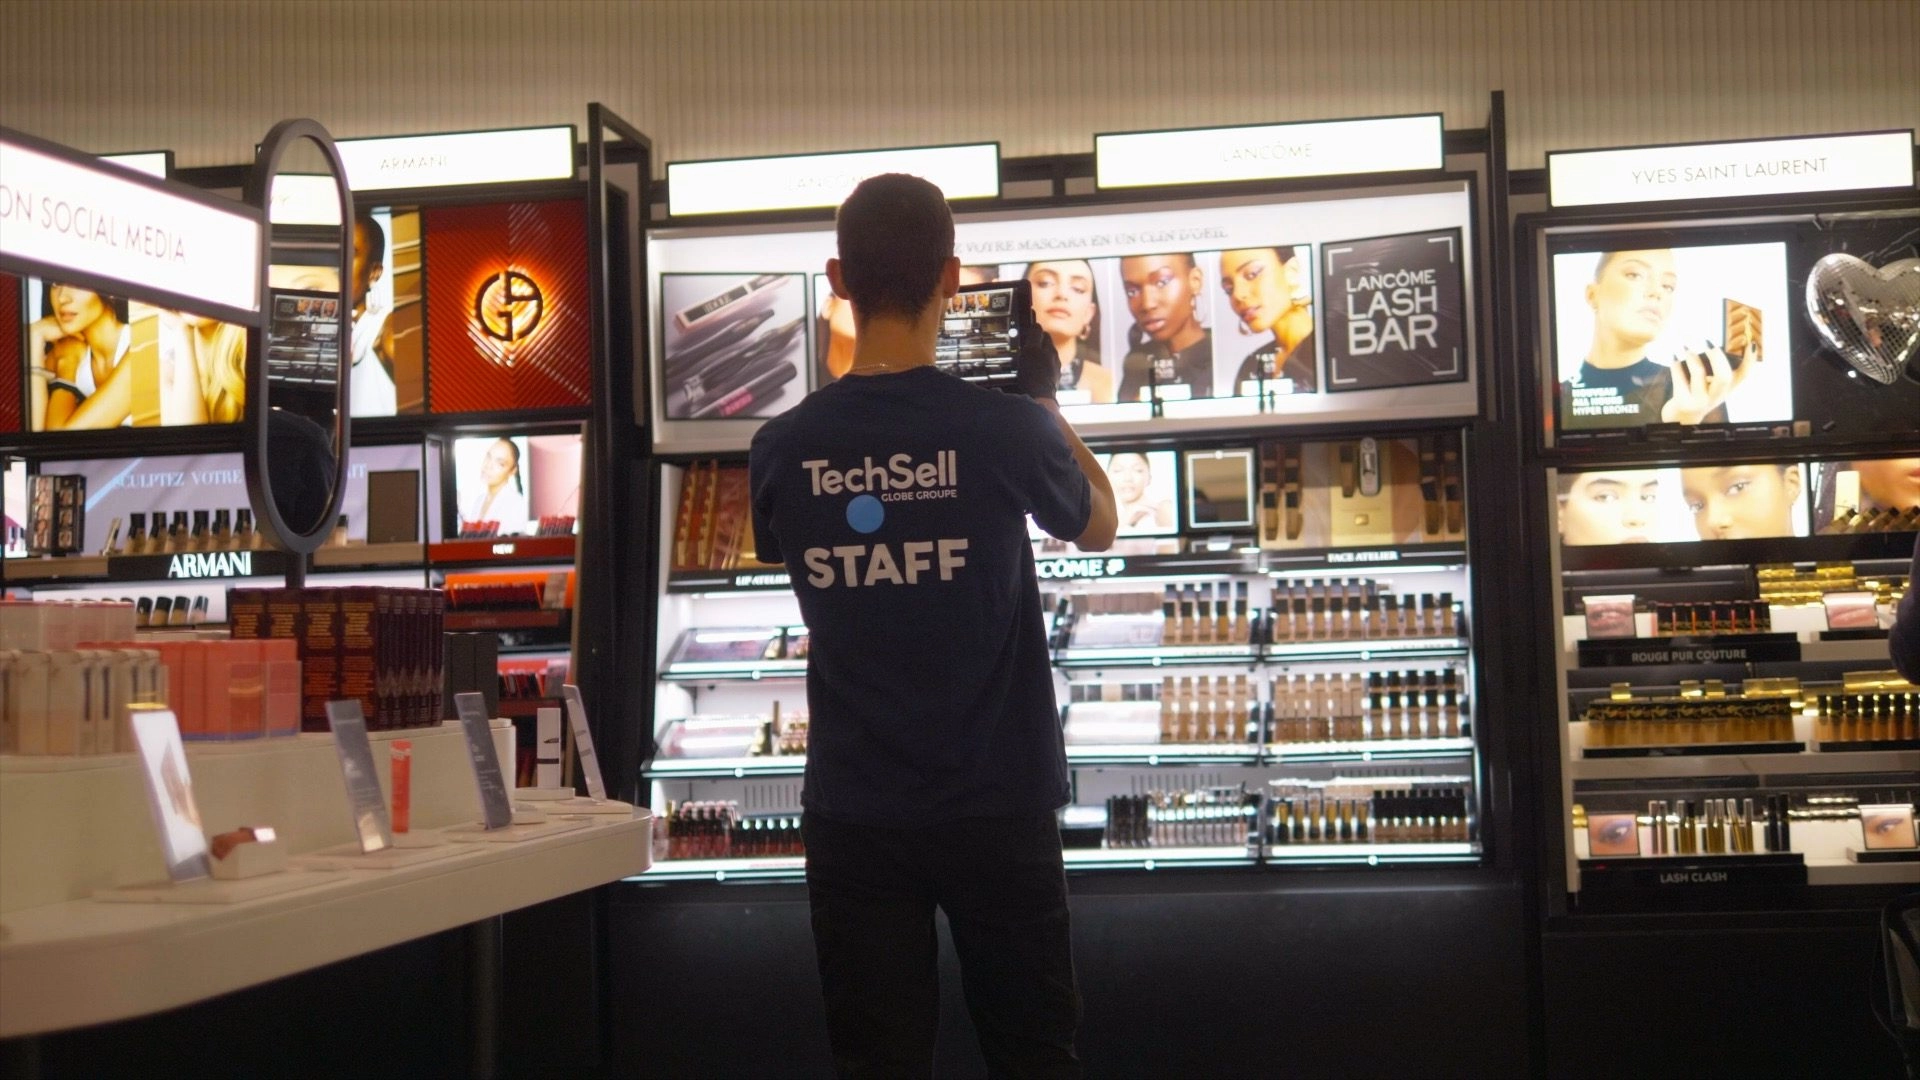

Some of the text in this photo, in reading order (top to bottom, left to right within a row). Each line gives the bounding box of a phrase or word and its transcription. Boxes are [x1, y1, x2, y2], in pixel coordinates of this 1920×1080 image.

[380, 155, 447, 170] ARMANI
[1632, 157, 1828, 185] YVES SAINT LAURENT
[0, 184, 187, 264] ON SOCIAL MEDIA
[1018, 237, 1087, 250] MASCARA
[1091, 233, 1110, 247] EN
[1115, 232, 1136, 244] UN
[1346, 268, 1436, 293] LANCÔME
[1347, 286, 1438, 321] LASH
[1348, 313, 1438, 357] BAR
[1572, 404, 1640, 415] HYPER BRONZE
[191, 469, 242, 485] VOTRE
[802, 450, 957, 496] TechSell
[881, 489, 957, 502] GLOBE GROUPE
[168, 551, 252, 579] ARMANI
[804, 538, 969, 590] STAFF
[1327, 550, 1398, 563] FACE ATELIER
[1035, 559, 1104, 579] CÔME
[735, 576, 752, 586] LIP
[1631, 649, 1747, 663] ROUGE PUR COUTURE
[1660, 872, 1727, 883] LASH CLASH
